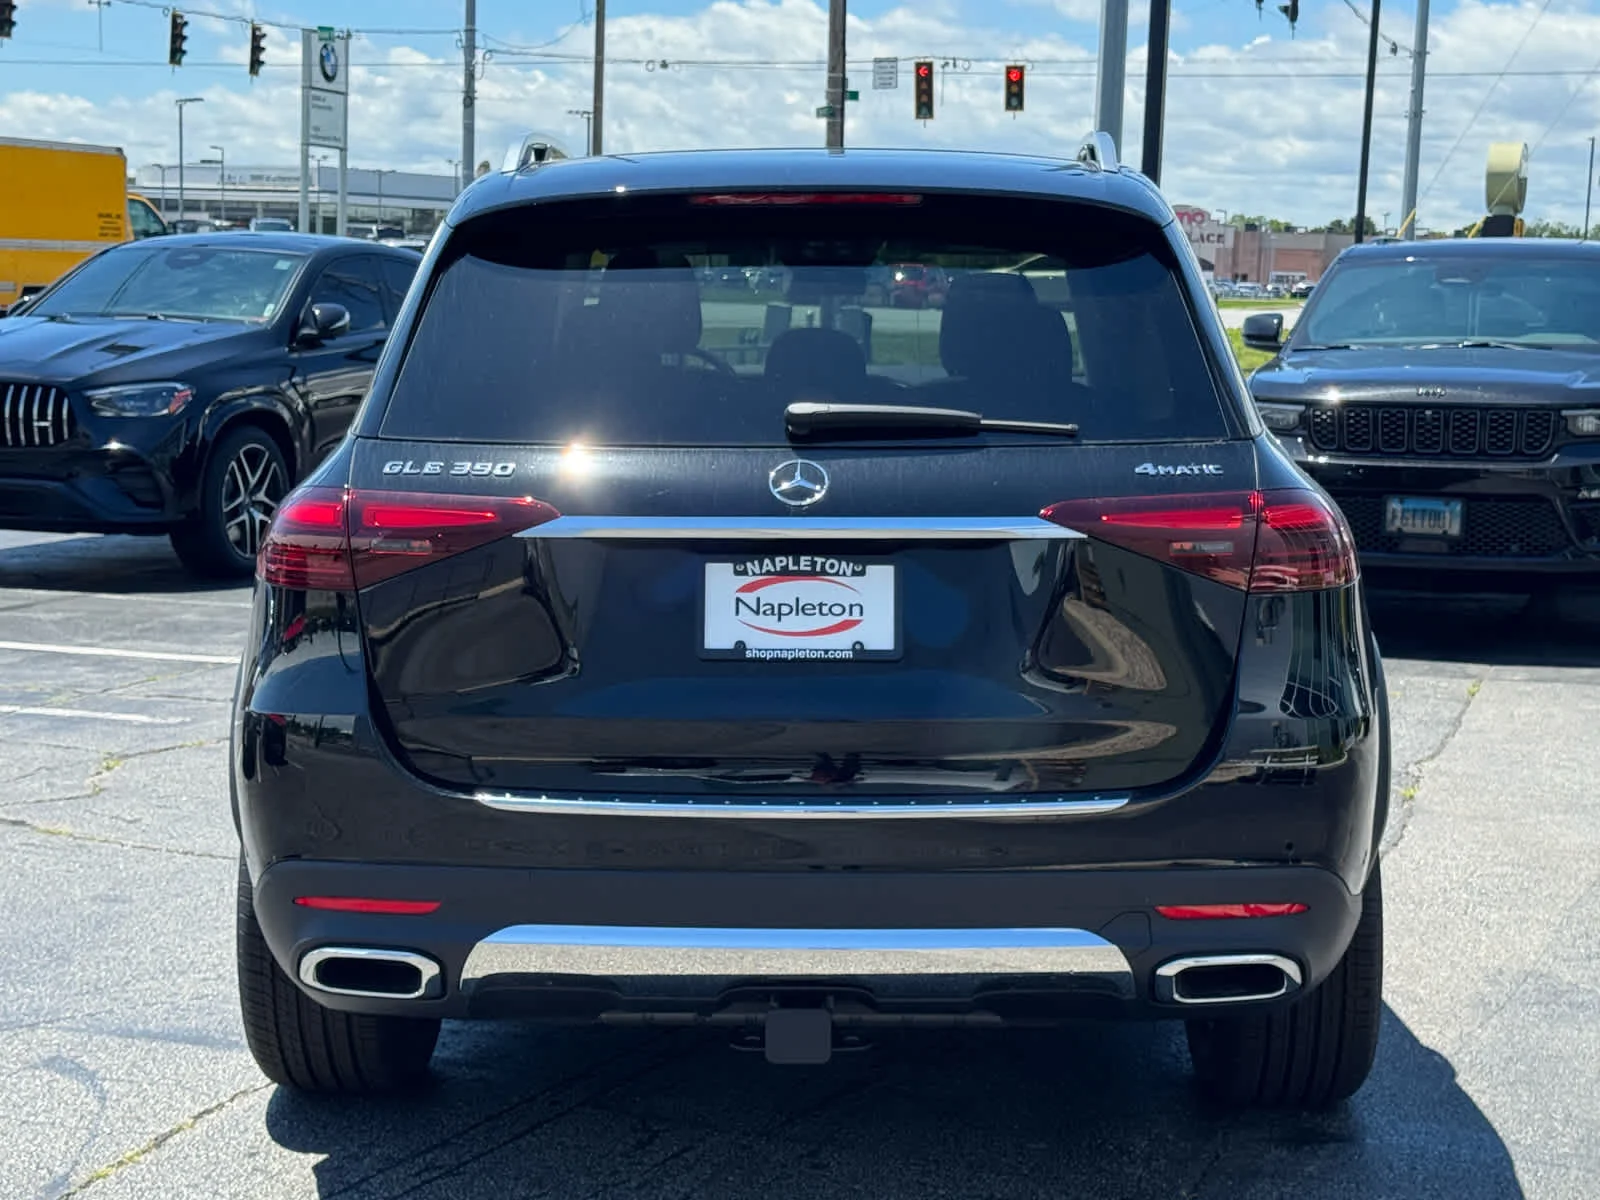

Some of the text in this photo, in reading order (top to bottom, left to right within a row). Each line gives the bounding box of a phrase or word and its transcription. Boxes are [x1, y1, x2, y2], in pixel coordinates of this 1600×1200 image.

[383, 461, 516, 477] GLE 350
[1135, 462, 1224, 475] 4MATIC
[746, 556, 854, 576] NAPLETON
[735, 596, 864, 622] Napleton
[745, 648, 853, 660] shopnapleton.com
